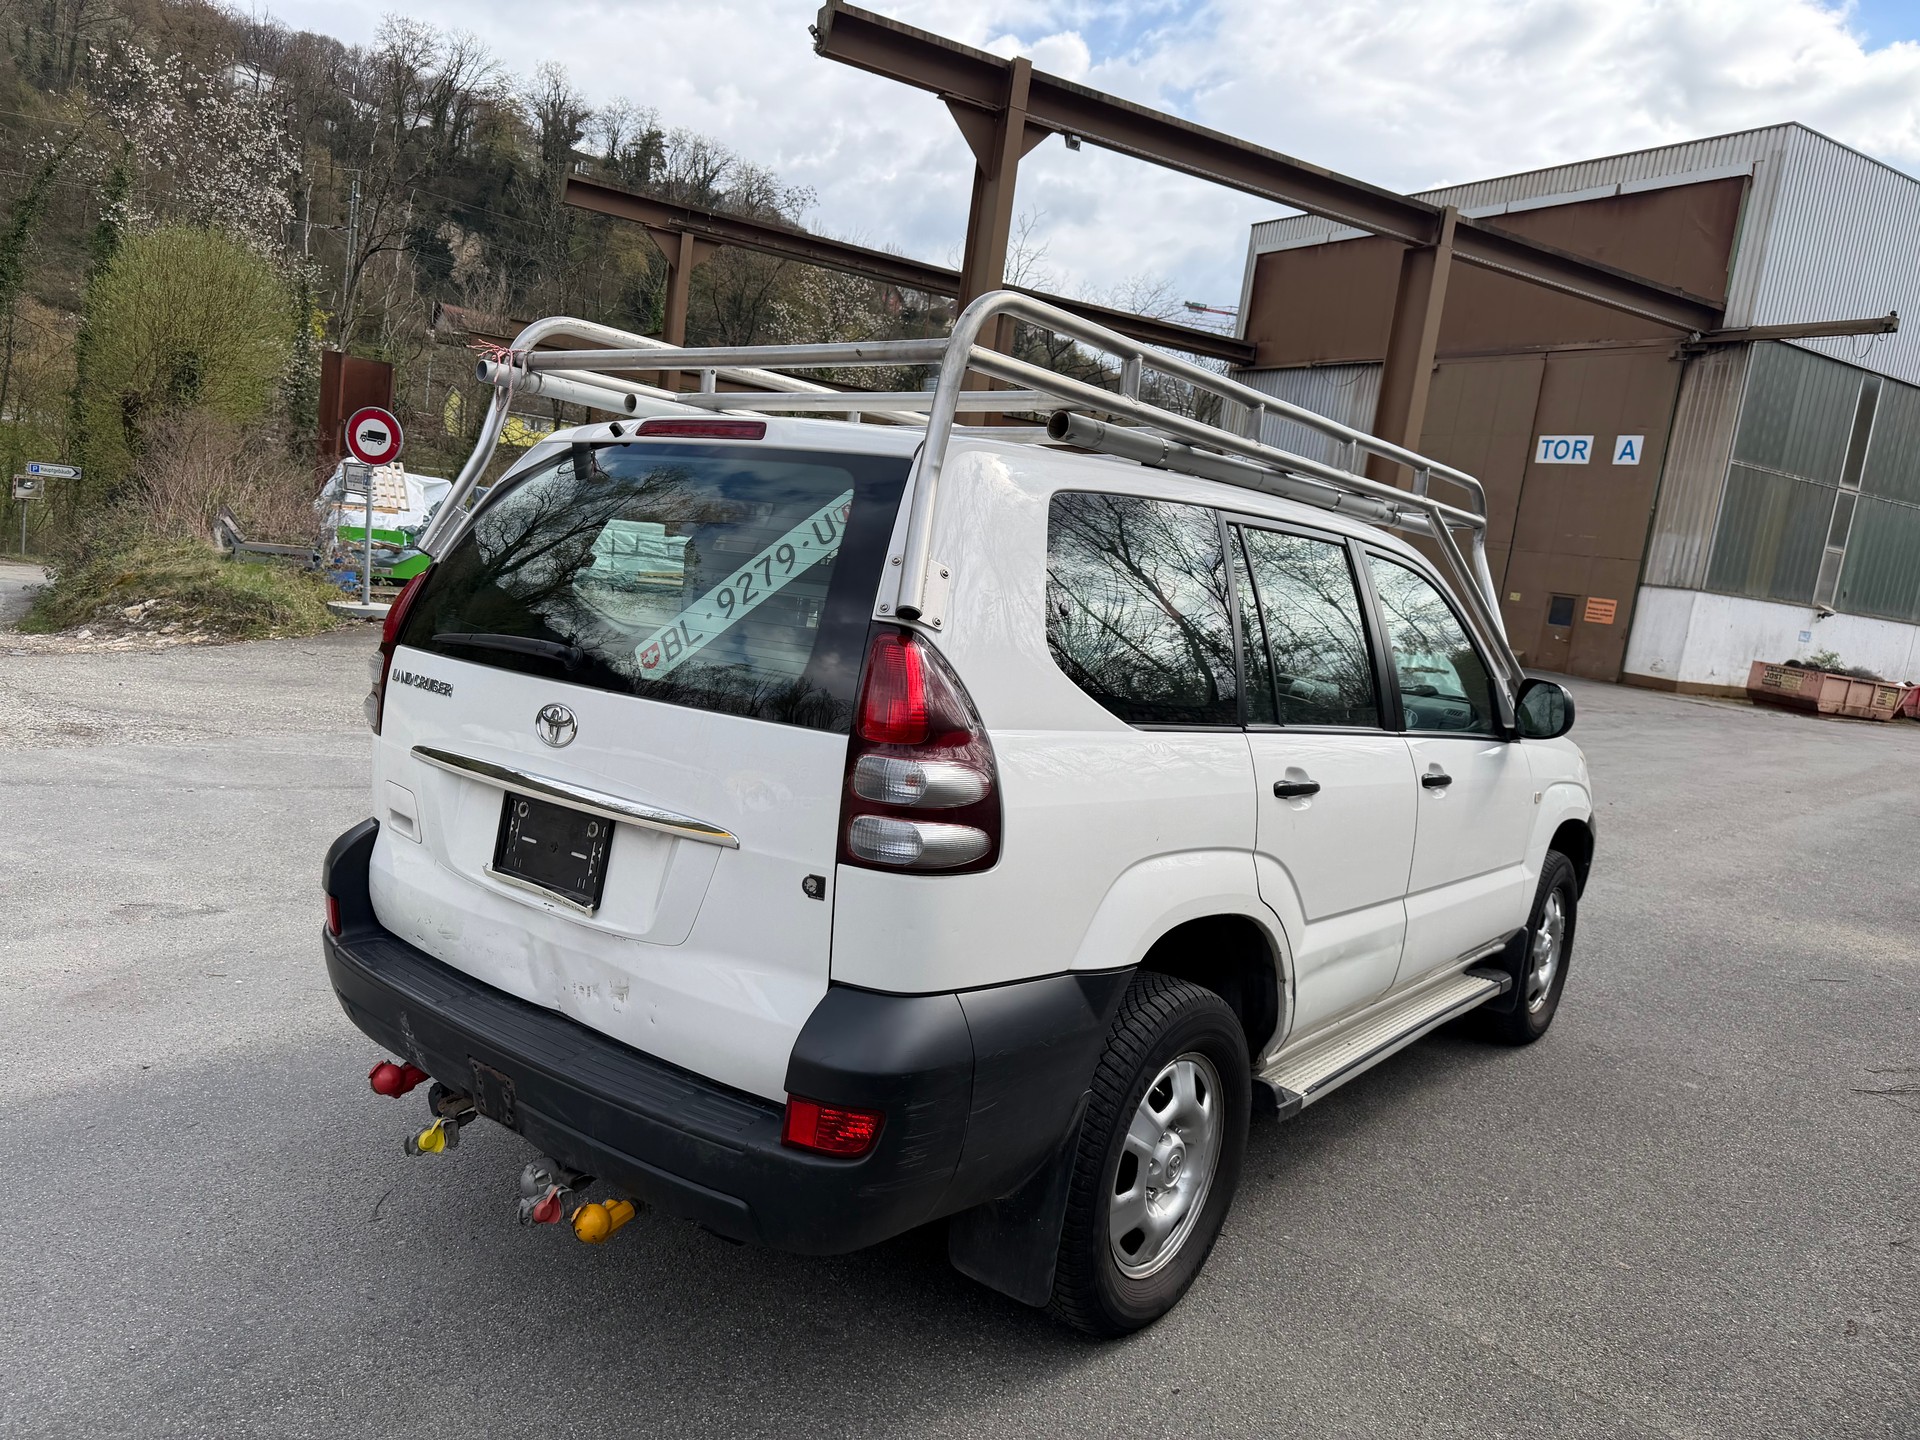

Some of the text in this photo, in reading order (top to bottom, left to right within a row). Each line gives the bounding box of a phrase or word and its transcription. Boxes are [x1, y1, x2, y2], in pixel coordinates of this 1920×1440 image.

[1541, 440, 1635, 460] TOR A
[41, 467, 72, 475] Hauptgebäude
[392, 668, 454, 697] LAND CRUISER
